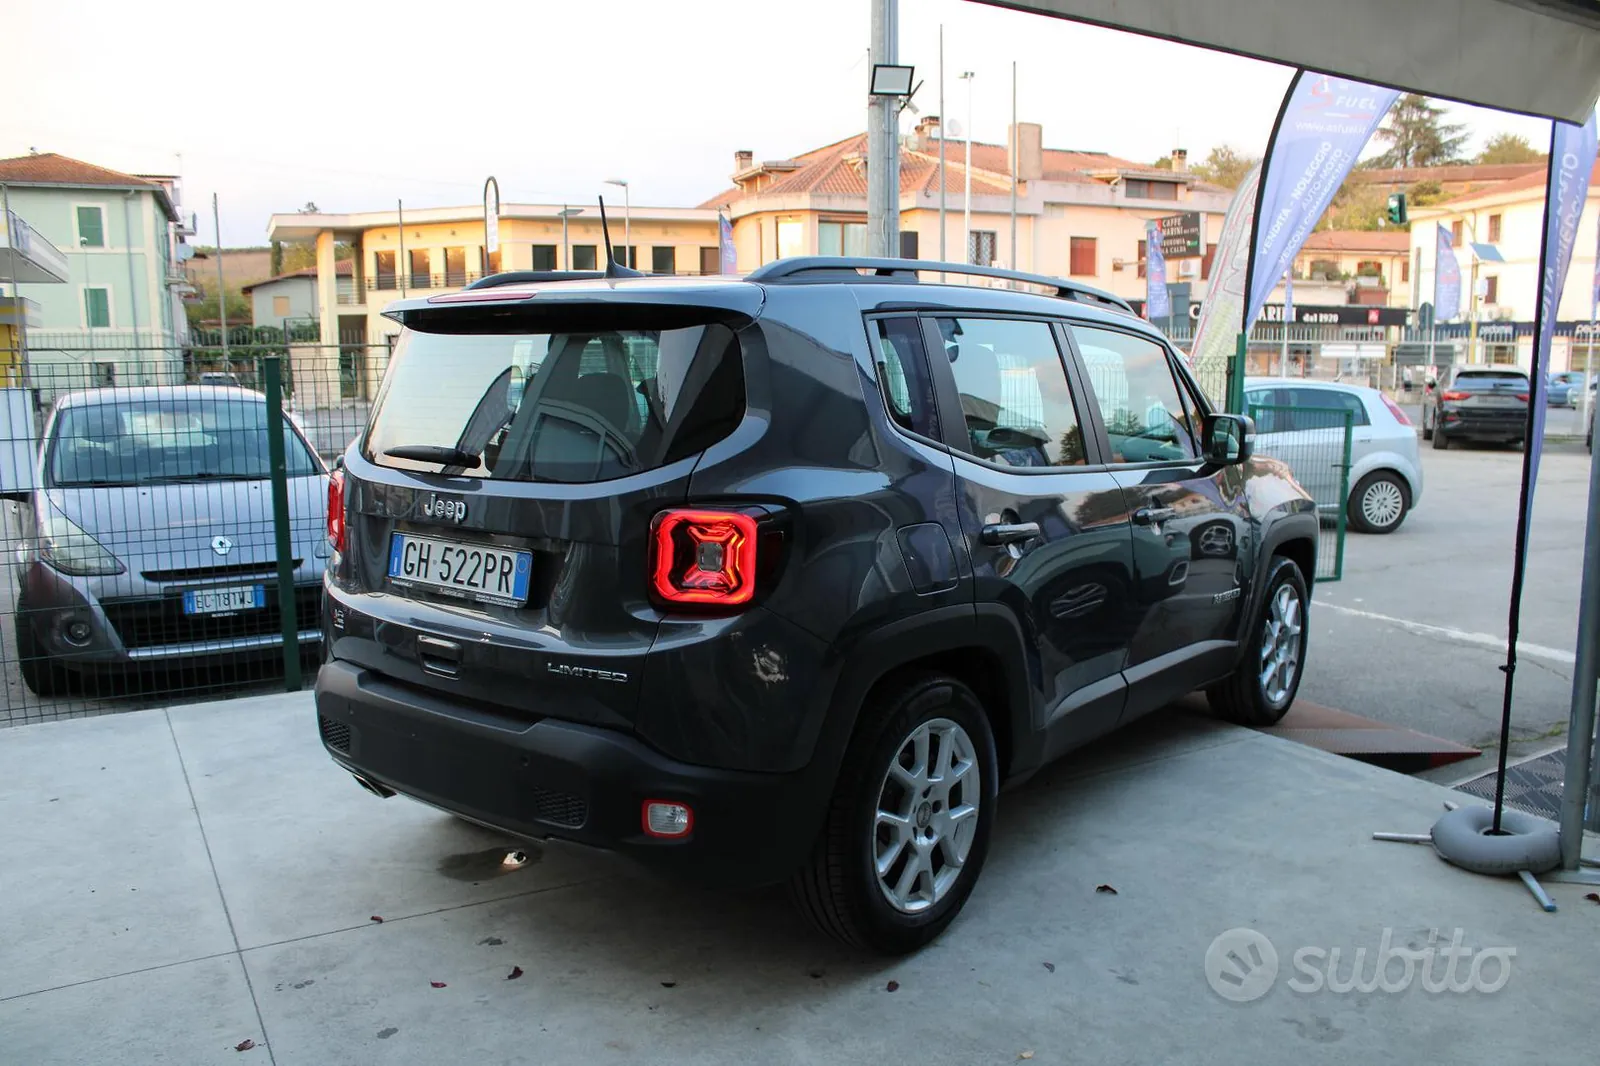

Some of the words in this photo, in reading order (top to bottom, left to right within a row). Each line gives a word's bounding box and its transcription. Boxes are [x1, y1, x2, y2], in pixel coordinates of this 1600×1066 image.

[1335, 95, 1377, 110] FUEL
[1261, 208, 1291, 255] VENDITA
[1291, 141, 1332, 200] NOLEGGIO
[1279, 229, 1305, 264] VEICOLI
[424, 493, 467, 524] Jeep
[403, 541, 432, 579] GH
[438, 546, 514, 593] 522PR
[547, 662, 628, 682] LIMITED
